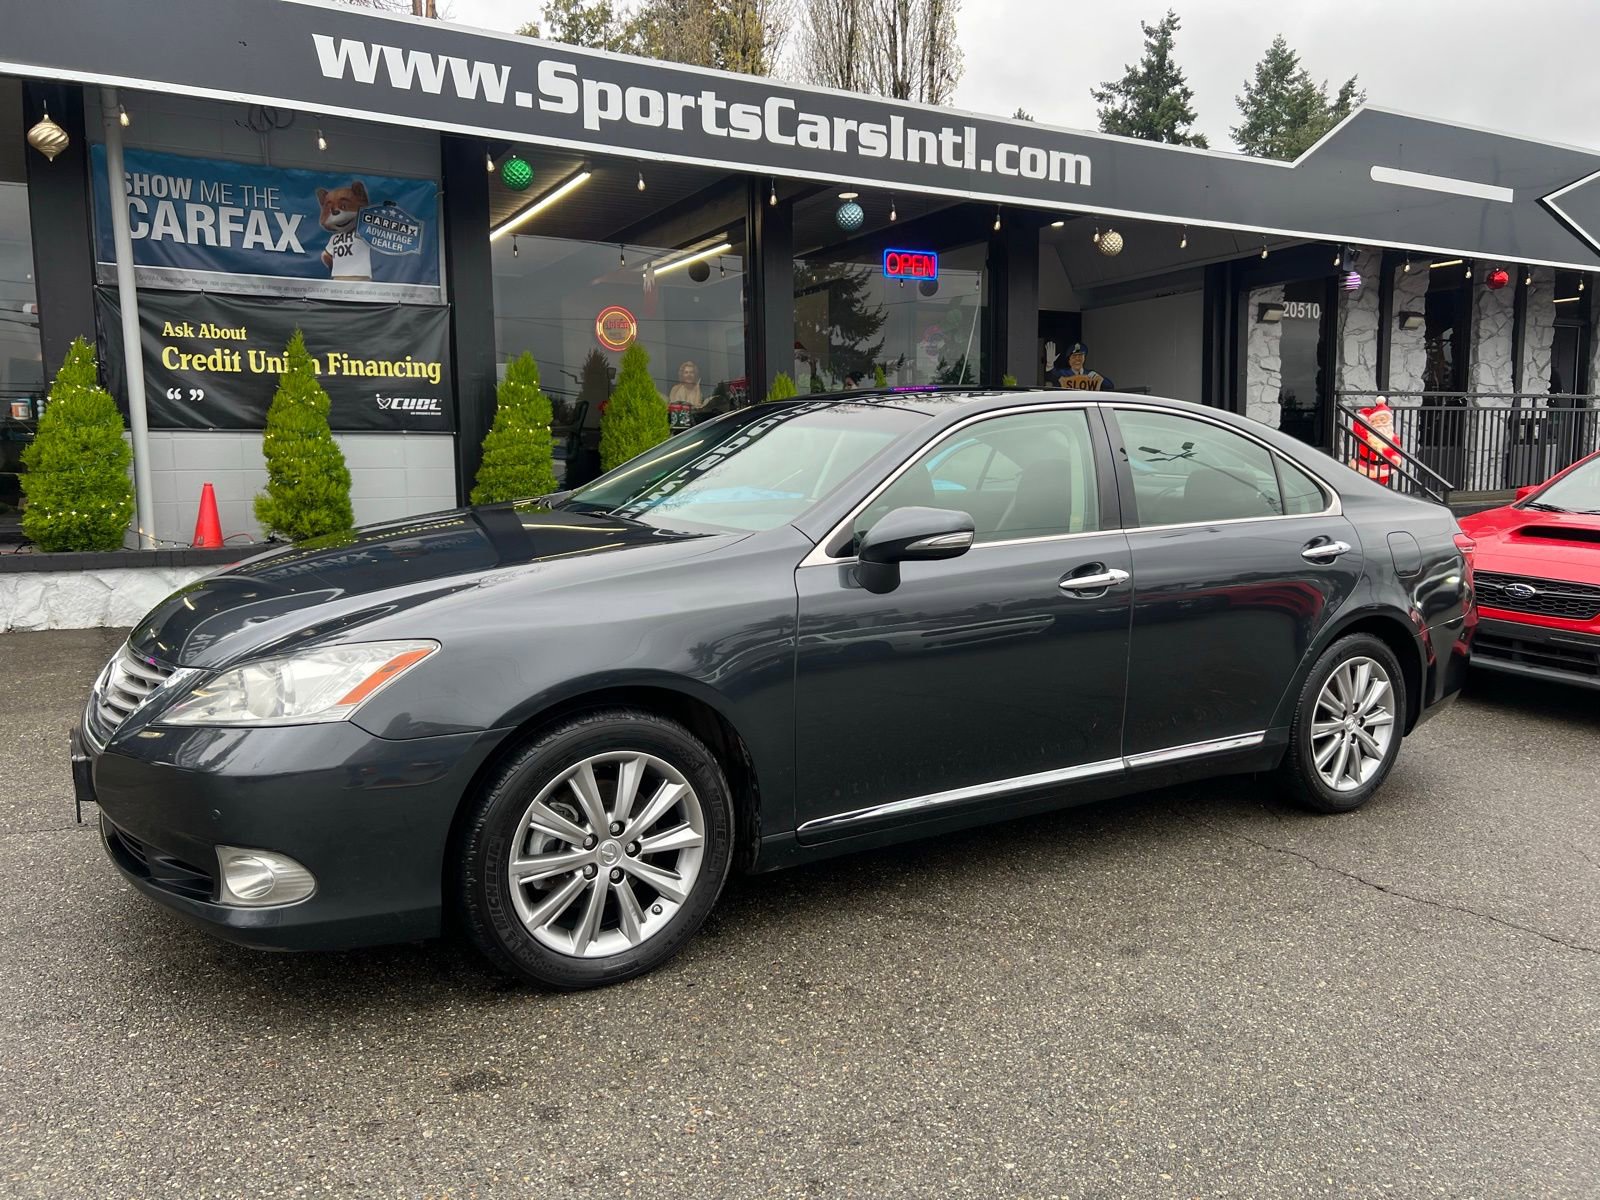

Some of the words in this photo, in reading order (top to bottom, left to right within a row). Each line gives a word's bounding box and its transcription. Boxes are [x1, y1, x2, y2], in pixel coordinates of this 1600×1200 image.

[311, 33, 1092, 187] www.SportsCarsIntl.com
[200, 180, 234, 205] ME
[240, 185, 281, 210] THE
[128, 196, 306, 254] CARFAX
[363, 213, 418, 236] CARFAX
[332, 231, 354, 246] CAR
[366, 225, 413, 245] ADVANTAGE
[371, 237, 404, 252] DEALER
[333, 243, 354, 258] FOX
[886, 252, 936, 277] OPEN
[1282, 301, 1321, 319] 20510
[162, 321, 196, 338] Ask
[198, 323, 248, 341] About
[161, 345, 242, 372] Credit
[247, 350, 322, 376] Unin
[327, 352, 442, 385] Financing
[1066, 379, 1099, 391] SLOW
